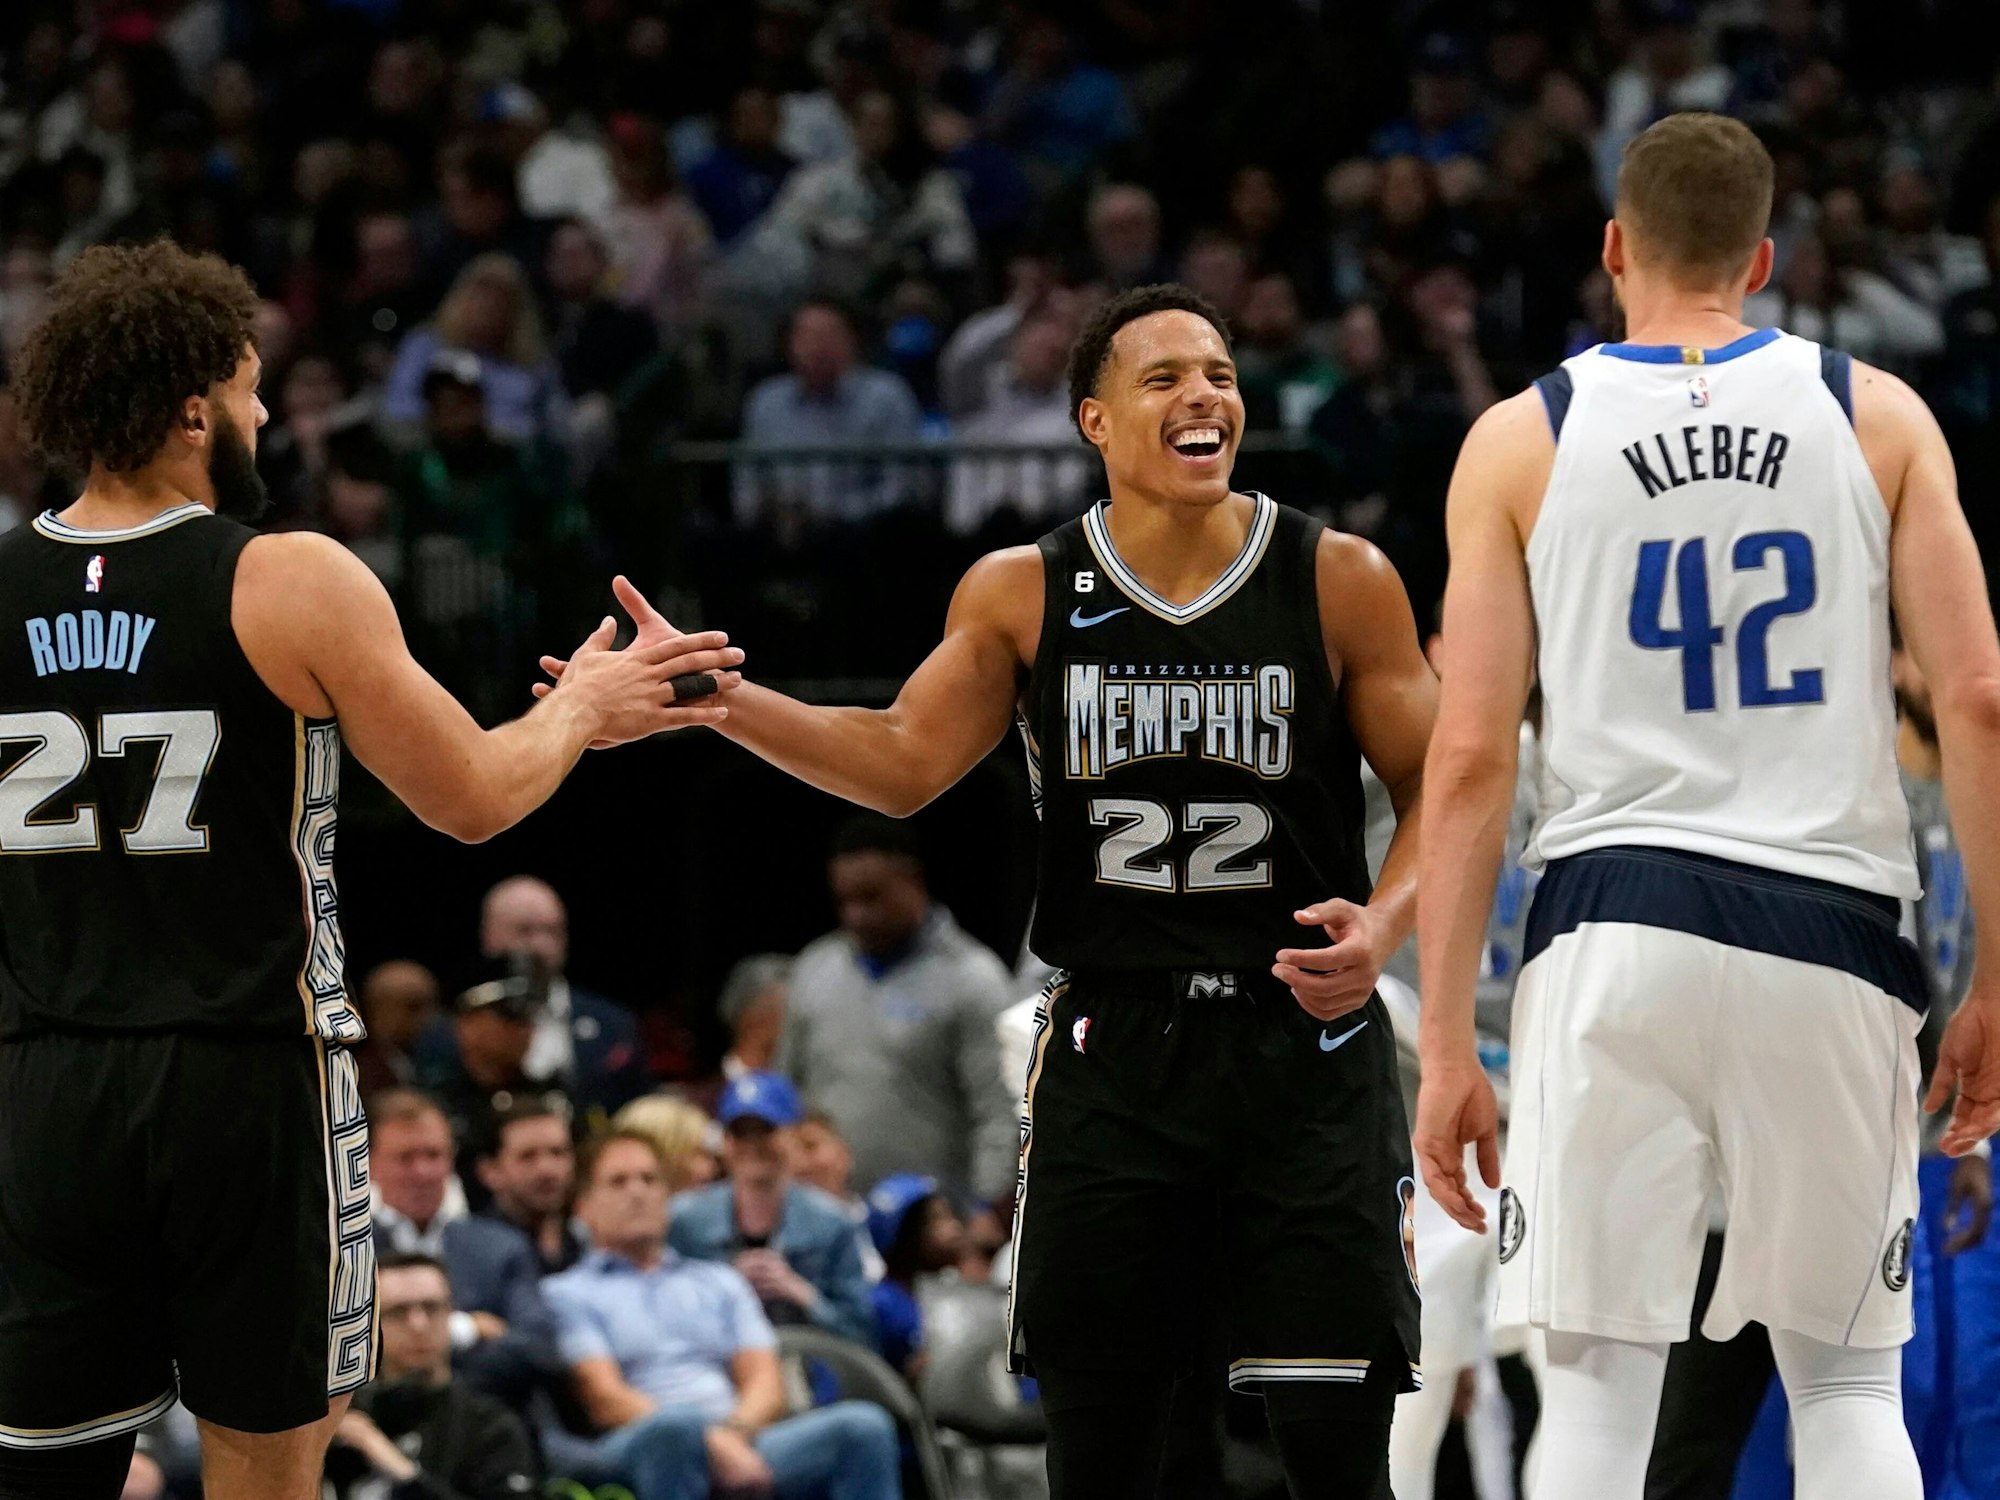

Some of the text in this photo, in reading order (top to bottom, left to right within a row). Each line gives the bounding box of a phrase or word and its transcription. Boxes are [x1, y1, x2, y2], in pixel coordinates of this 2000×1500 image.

[1622, 424, 1789, 499] KLEBER
[1075, 572, 1095, 592] 6
[1628, 530, 1825, 713] 42
[26, 609, 156, 677] RODDY
[1108, 664, 1251, 676] GRIZZLIES
[1065, 662, 1295, 780] MEMPHIS
[0, 711, 222, 854] 27
[1089, 798, 1273, 893] 22
